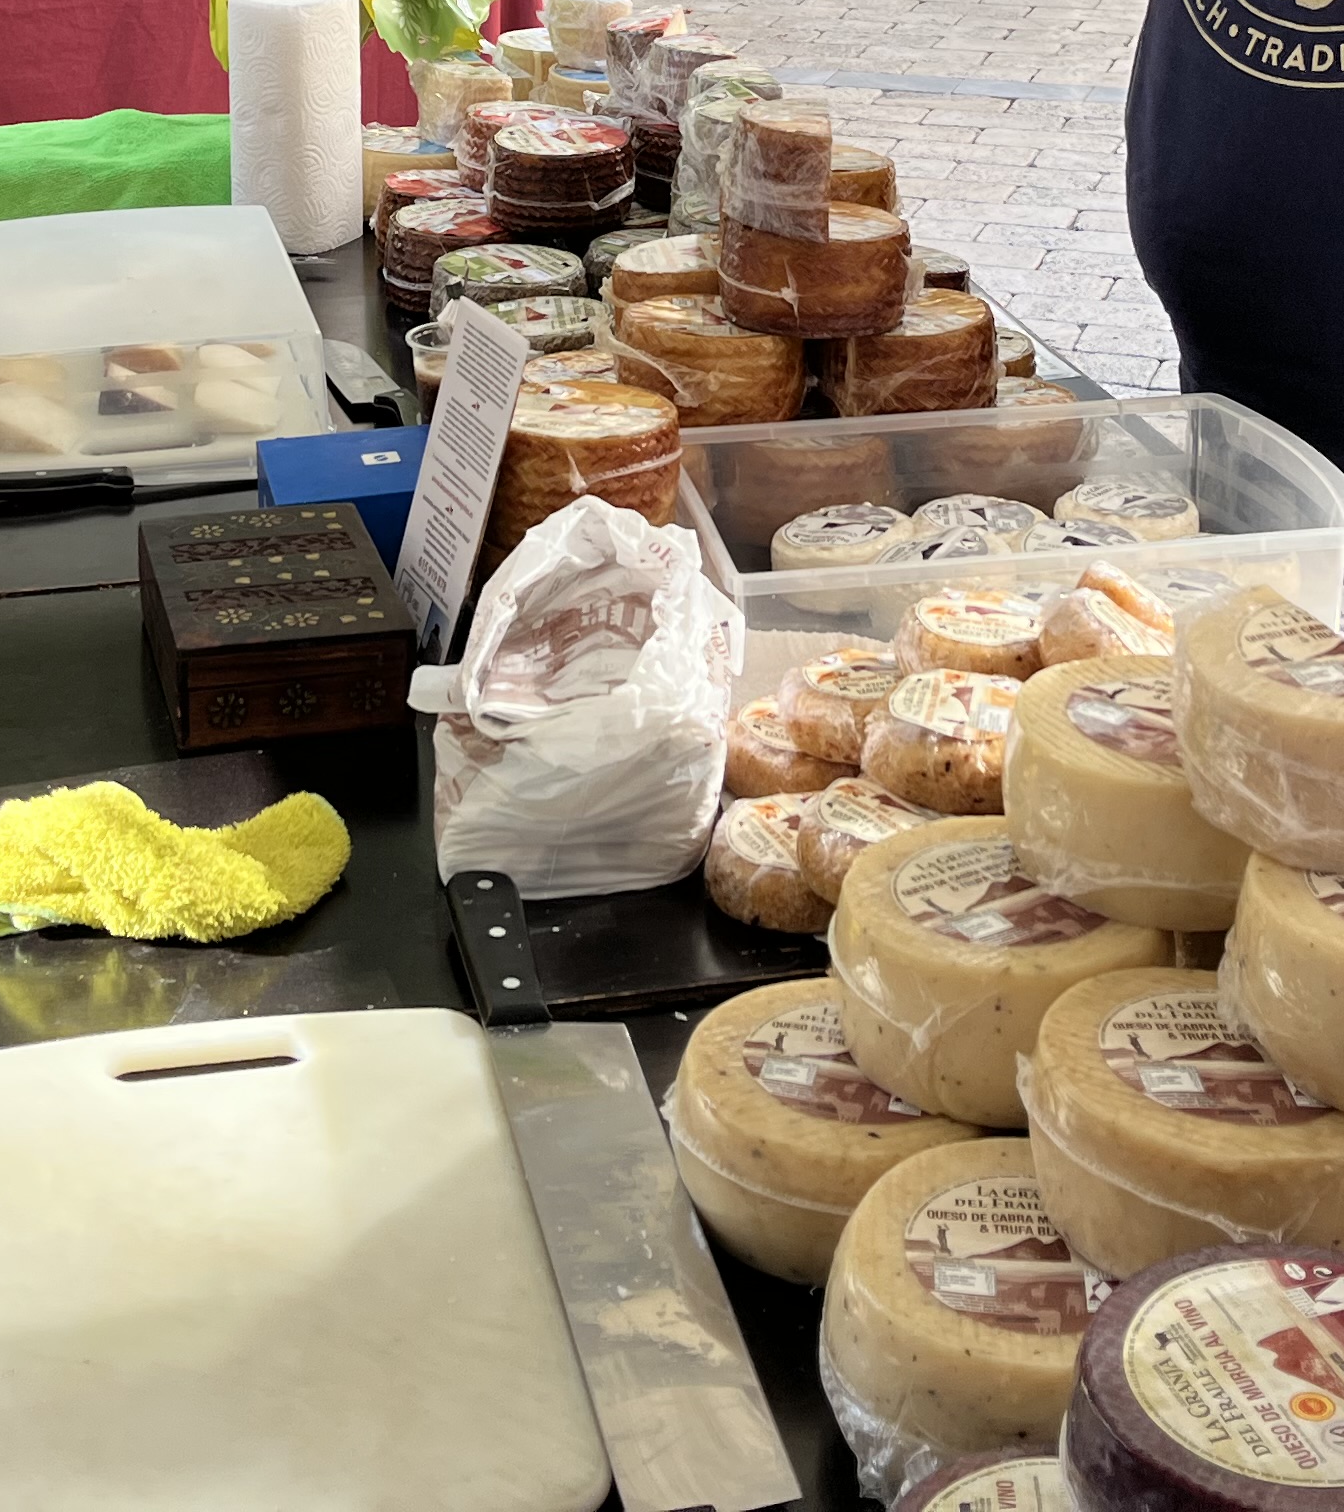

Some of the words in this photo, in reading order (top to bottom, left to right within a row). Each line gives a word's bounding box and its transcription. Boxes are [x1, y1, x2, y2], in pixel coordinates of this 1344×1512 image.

[1135, 1011, 1167, 1020] DEL
[1171, 1010, 1220, 1020] FRAIL
[1152, 1001, 1173, 1011] LA
[1178, 1000, 1217, 1011] GRA
[1113, 1022, 1153, 1031] QUESO
[1156, 1023, 1172, 1031] DE
[1175, 1023, 1217, 1032] CABRA
[1181, 1032, 1221, 1041] TRUFA
[977, 1186, 999, 1198] LA
[1003, 1188, 1040, 1201] GRA
[955, 1198, 987, 1209] DEL
[992, 1198, 1044, 1212] FRAIL
[926, 1209, 968, 1222] QUESO
[971, 1212, 988, 1223] DE
[991, 1213, 1034, 1225] CABRA
[979, 1224, 989, 1234] &
[993, 1224, 1035, 1236] TRUFA
[1174, 1298, 1208, 1331] VINO
[1200, 1329, 1225, 1349] AL
[1214, 1349, 1265, 1401] MURCIA
[1158, 1356, 1211, 1419] GRANJA
[1195, 1368, 1246, 1424] FRAILE
[1254, 1403, 1282, 1425] DE
[1205, 1420, 1232, 1445] LA
[1238, 1423, 1273, 1458] DEL
[1271, 1425, 1318, 1470] QUESO
[996, 1480, 1017, 1509] VINO
